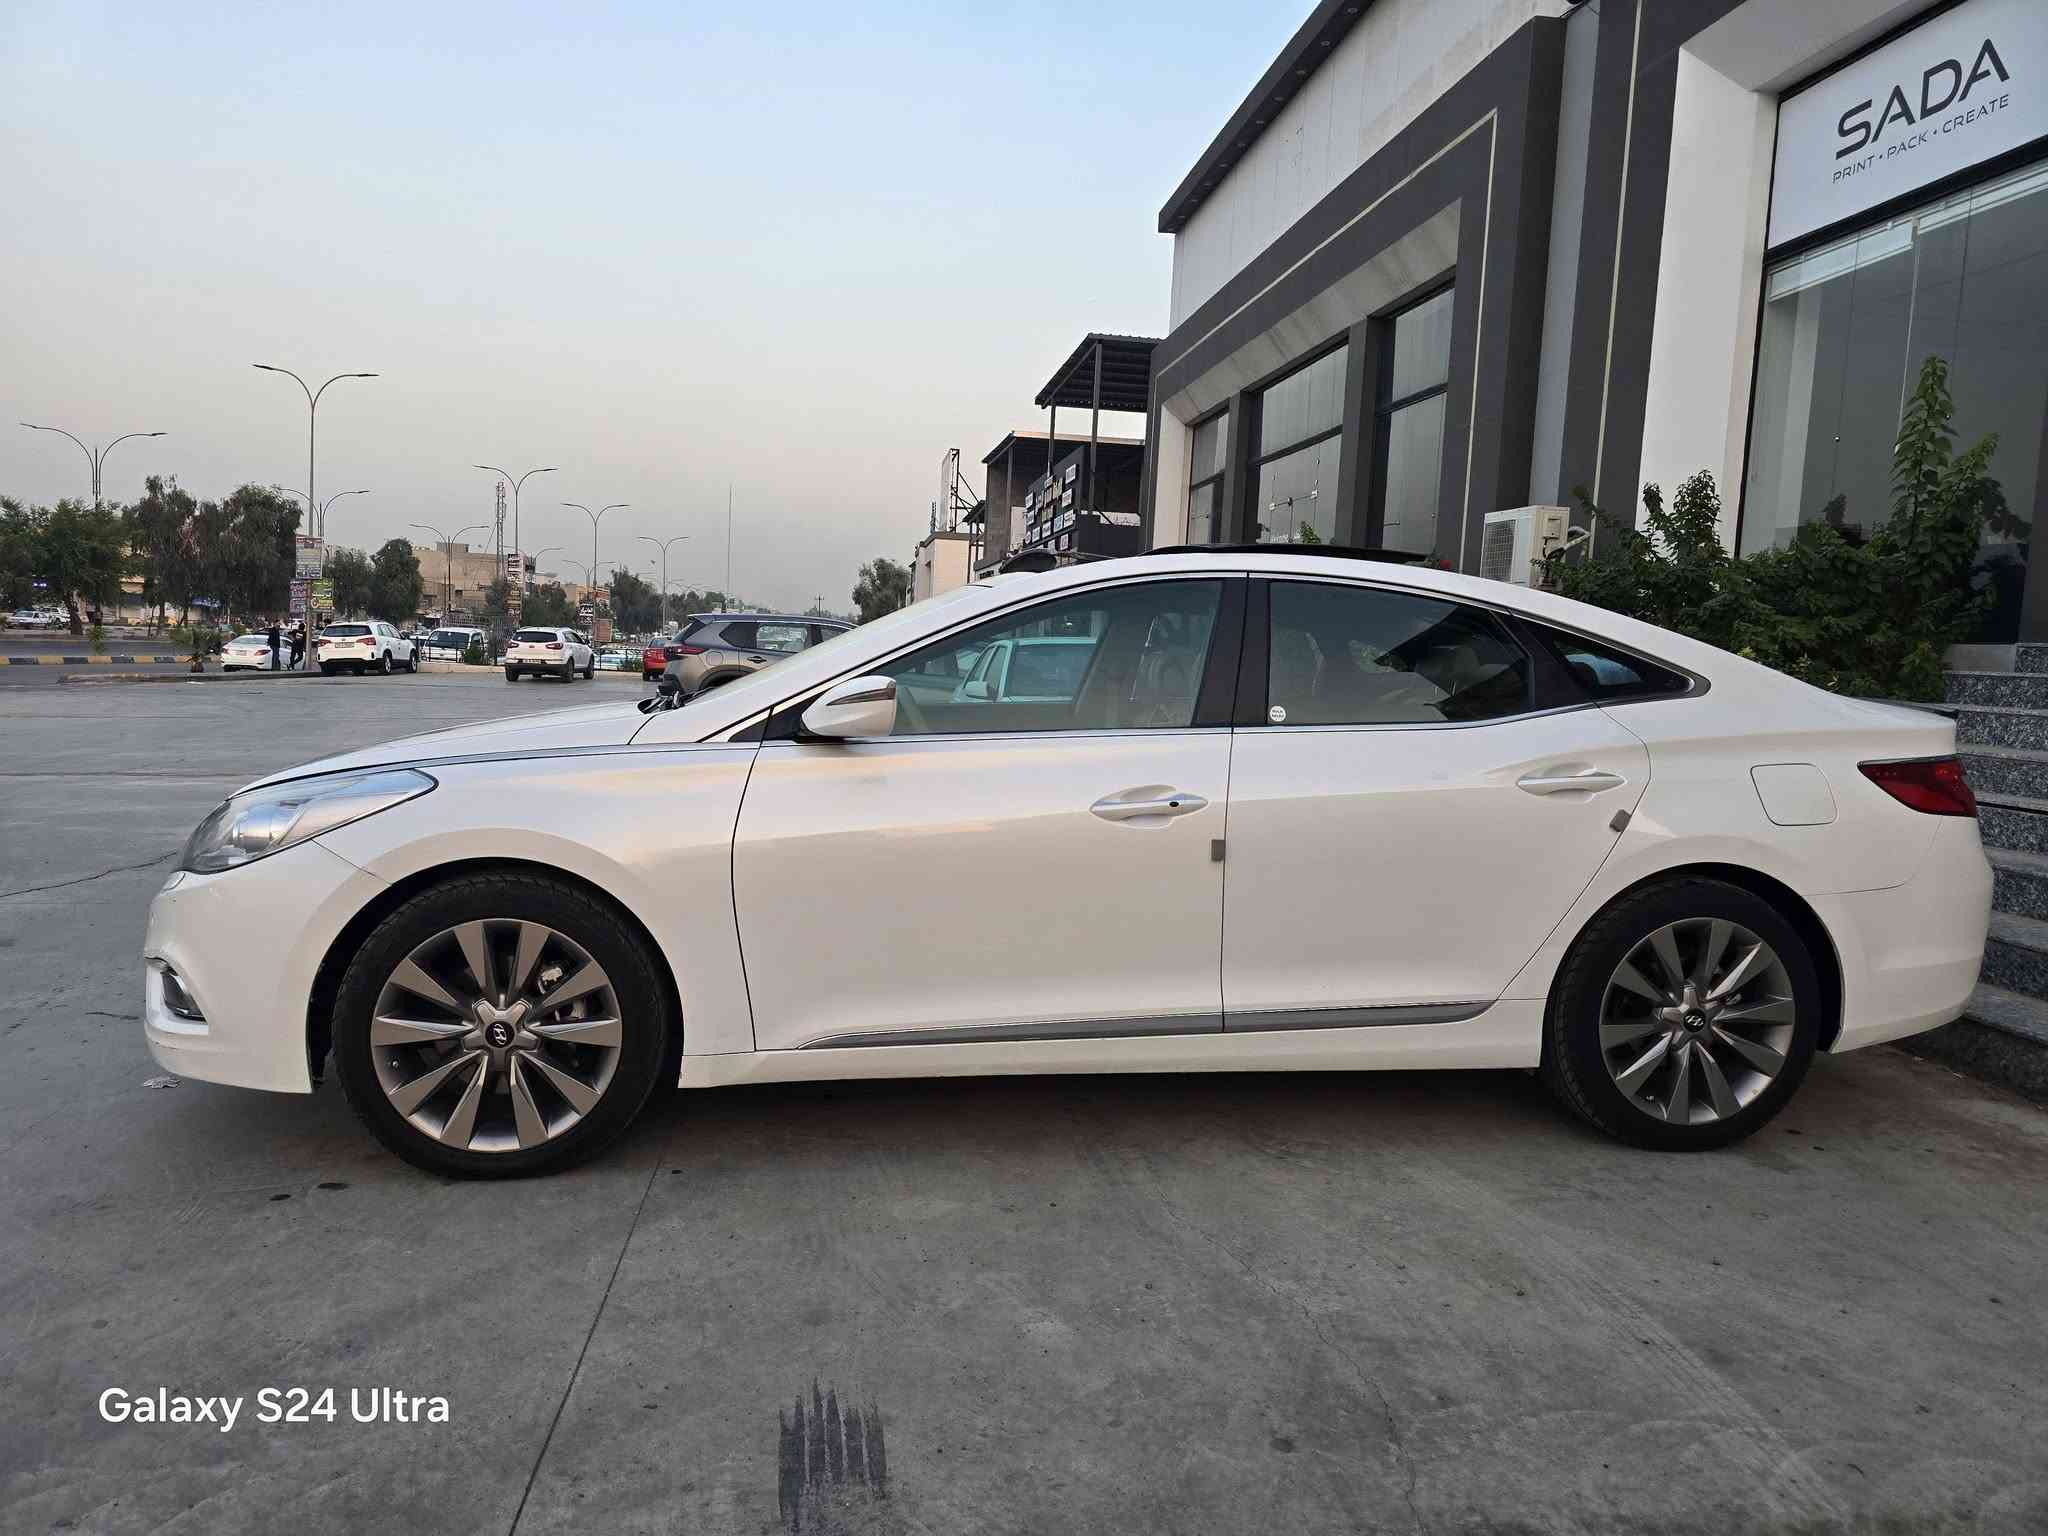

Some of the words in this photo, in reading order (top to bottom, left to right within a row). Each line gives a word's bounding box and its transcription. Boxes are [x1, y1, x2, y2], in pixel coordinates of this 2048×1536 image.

[1832, 156, 1874, 184] PRINT
[1887, 130, 1928, 160] PACK
[1942, 94, 2009, 134] CREATE
[1835, 38, 2010, 160] SADA
